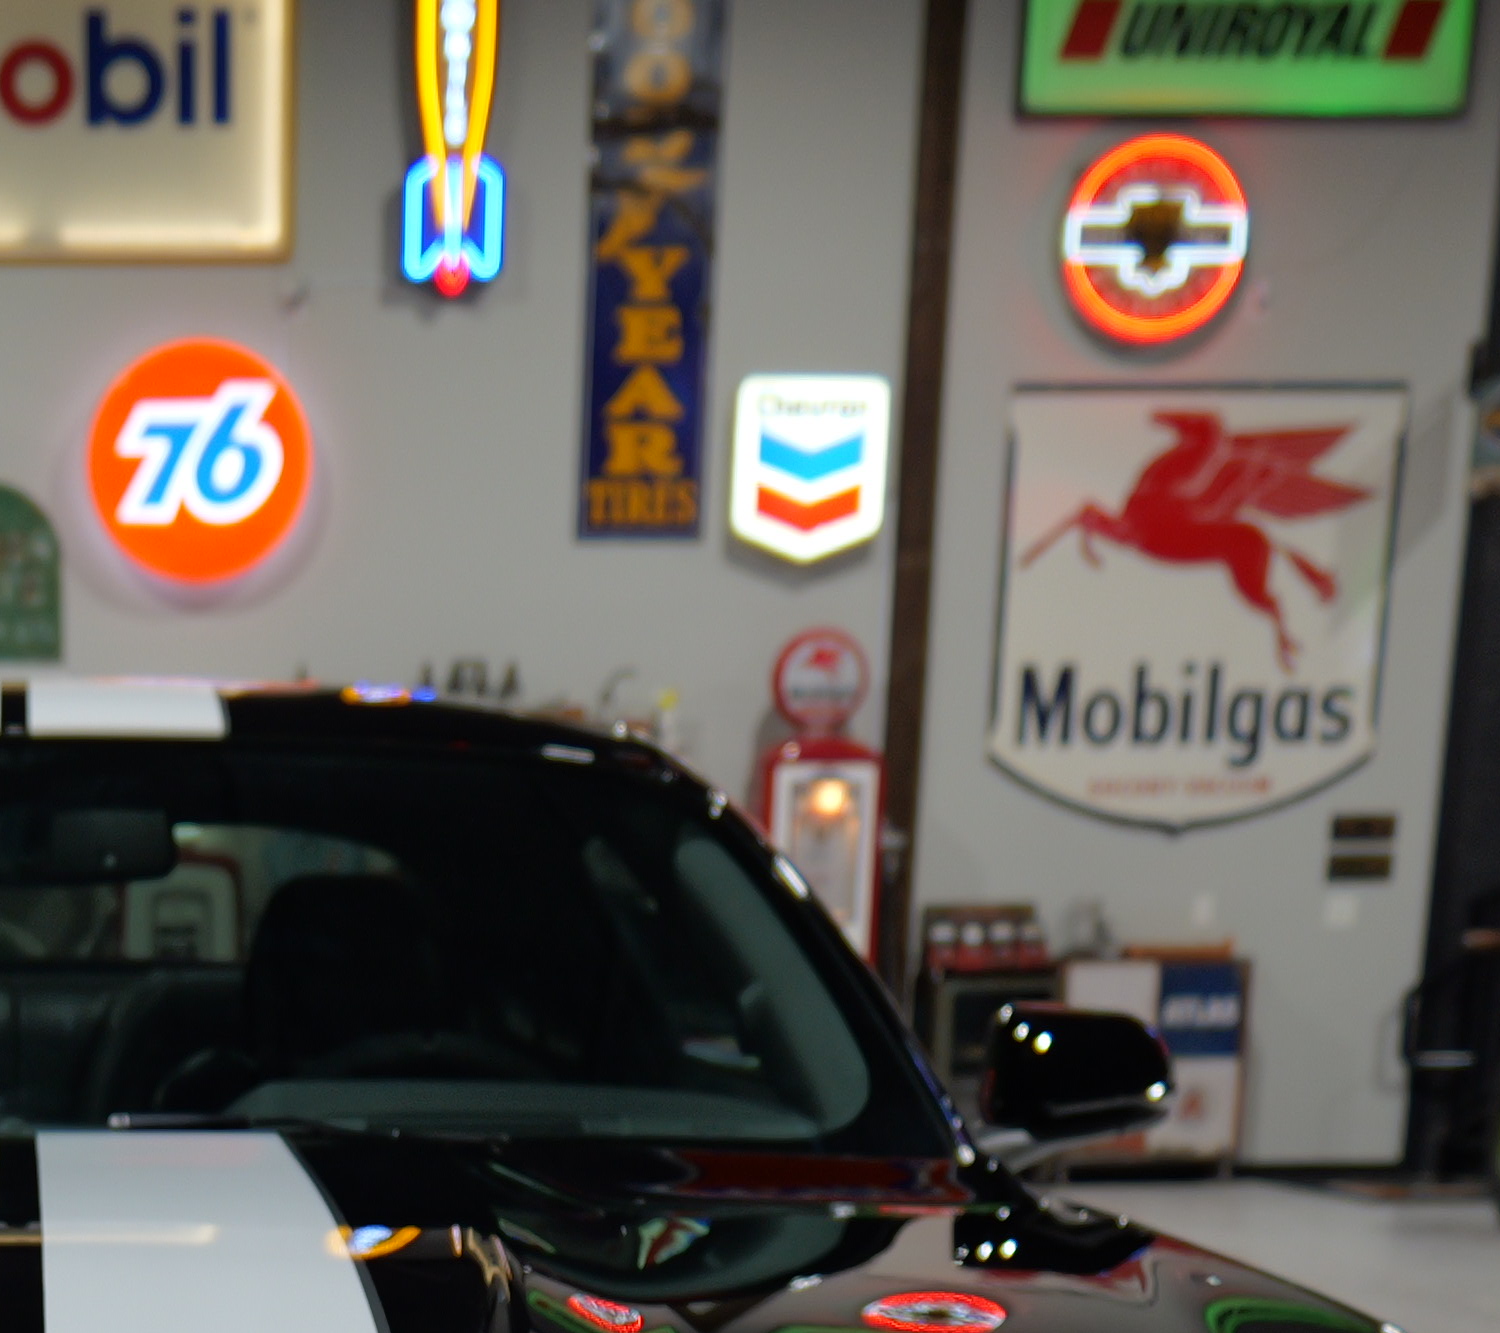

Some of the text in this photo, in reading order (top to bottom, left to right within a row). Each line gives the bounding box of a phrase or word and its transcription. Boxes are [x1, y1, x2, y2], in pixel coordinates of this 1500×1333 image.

[1120, 0, 1378, 57] UNIROYAL
[113, 376, 285, 526] 76
[1017, 661, 1355, 768] Mobilgas
